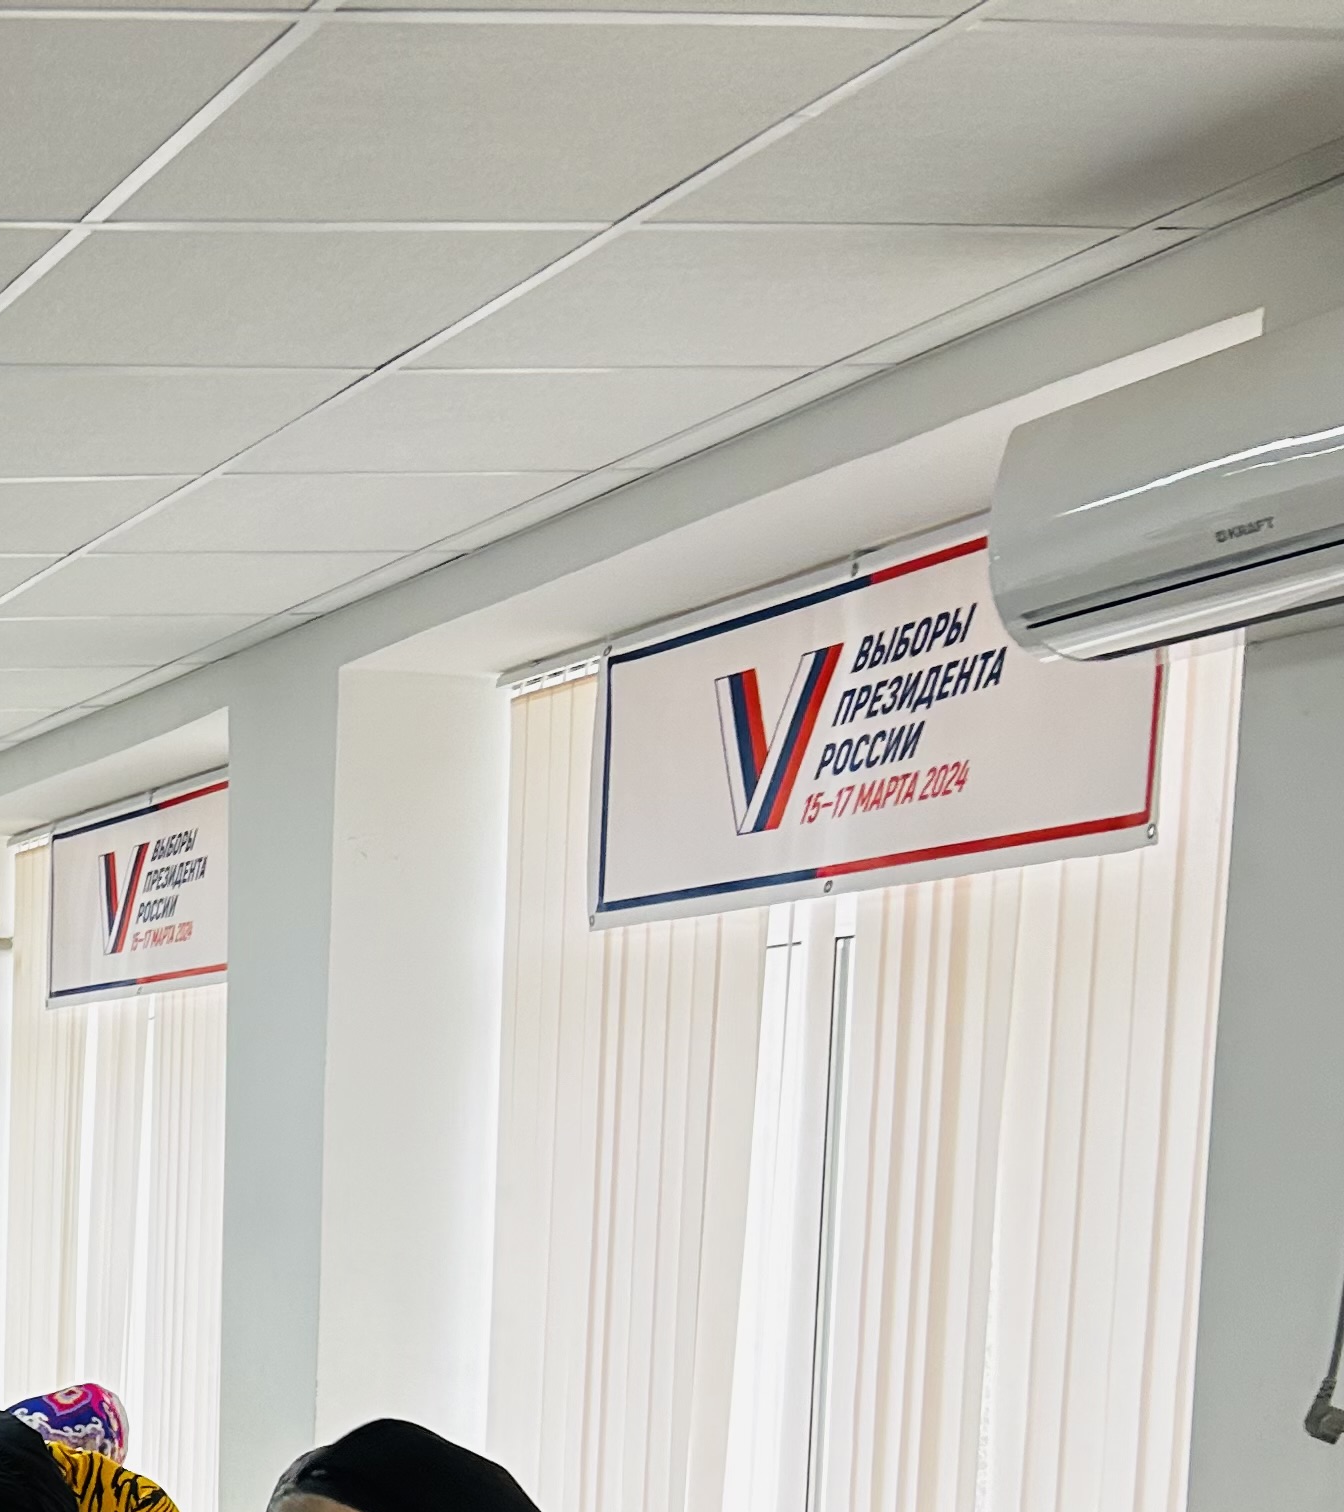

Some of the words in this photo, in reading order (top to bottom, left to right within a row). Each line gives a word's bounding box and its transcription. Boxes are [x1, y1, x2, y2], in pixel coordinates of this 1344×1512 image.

[850, 602, 977, 674] ВЫБОРЫ
[831, 646, 1008, 727] ПРЕЗИДЕНТА
[813, 720, 925, 780] РОССИИ
[852, 770, 921, 815] МАРТА
[917, 759, 970, 801] 2024
[150, 827, 198, 862] ВЫБОРЫ
[142, 855, 208, 894] ПРЕЗИДЕНТА
[135, 894, 179, 925] РОССИИ
